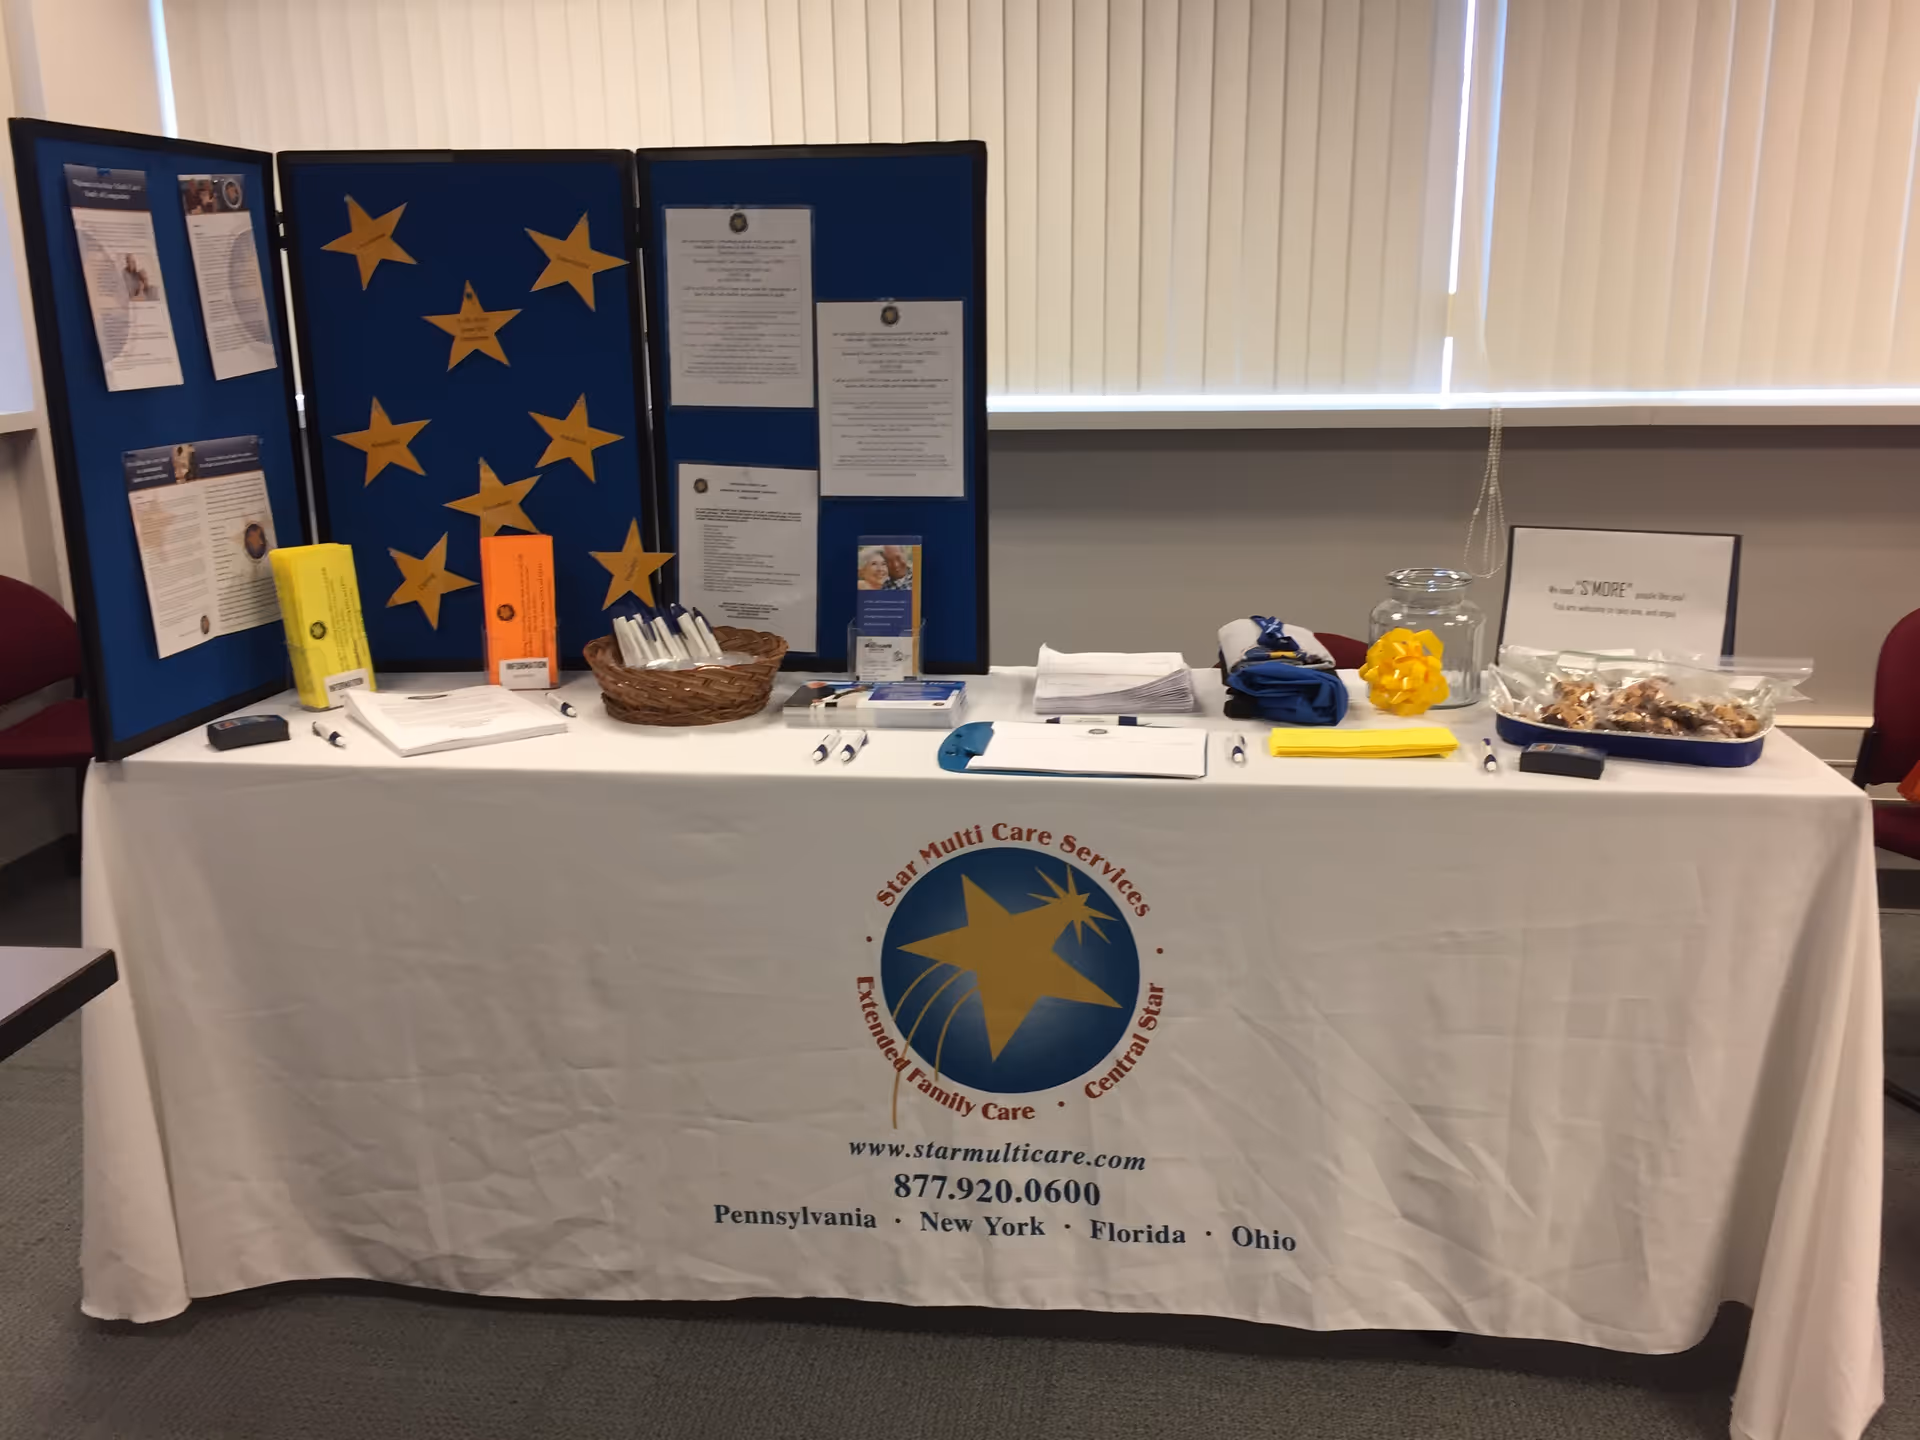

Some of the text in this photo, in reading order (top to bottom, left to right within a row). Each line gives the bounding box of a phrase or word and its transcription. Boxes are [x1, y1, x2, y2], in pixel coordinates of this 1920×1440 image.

[506, 661, 547, 670] INFORMATION
[329, 677, 364, 692] INFORMATION
[875, 822, 1151, 918] Star Multi Care Services
[856, 975, 1166, 1121] Extended Family Care Central Star
[848, 1137, 1147, 1172] www.starmulticare.com
[893, 1173, 1101, 1207] 877.920.0600
[713, 1204, 1297, 1253] Pennsylvania New York Florida Ohio
